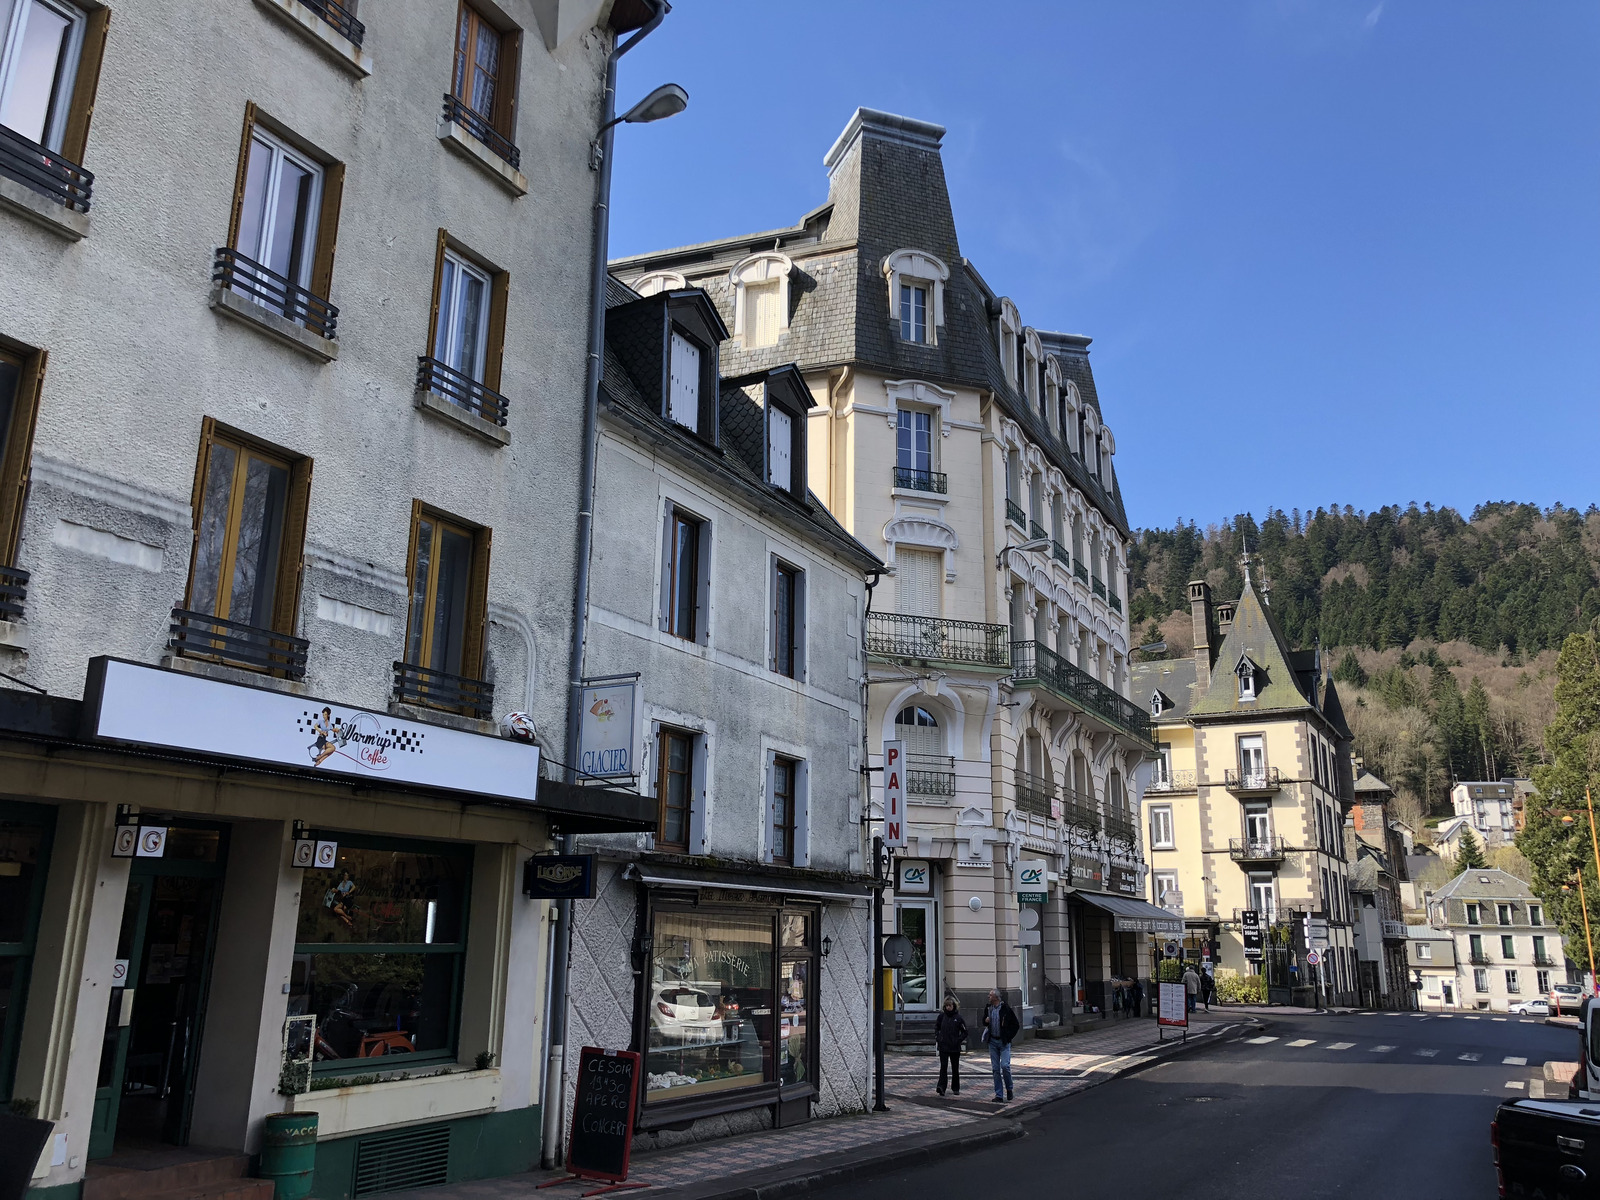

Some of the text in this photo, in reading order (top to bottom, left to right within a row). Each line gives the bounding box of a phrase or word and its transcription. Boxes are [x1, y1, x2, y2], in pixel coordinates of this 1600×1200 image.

[341, 722, 391, 754] Warm'up
[361, 746, 388, 765] Coffee
[582, 748, 627, 774] GLACIER
[888, 748, 900, 840] PAIN
[536, 863, 583, 880] LICORNE
[704, 949, 750, 977] PATISSERIE
[587, 1058, 632, 1078] CE SOIR
[582, 1111, 627, 1137] CONCERT
